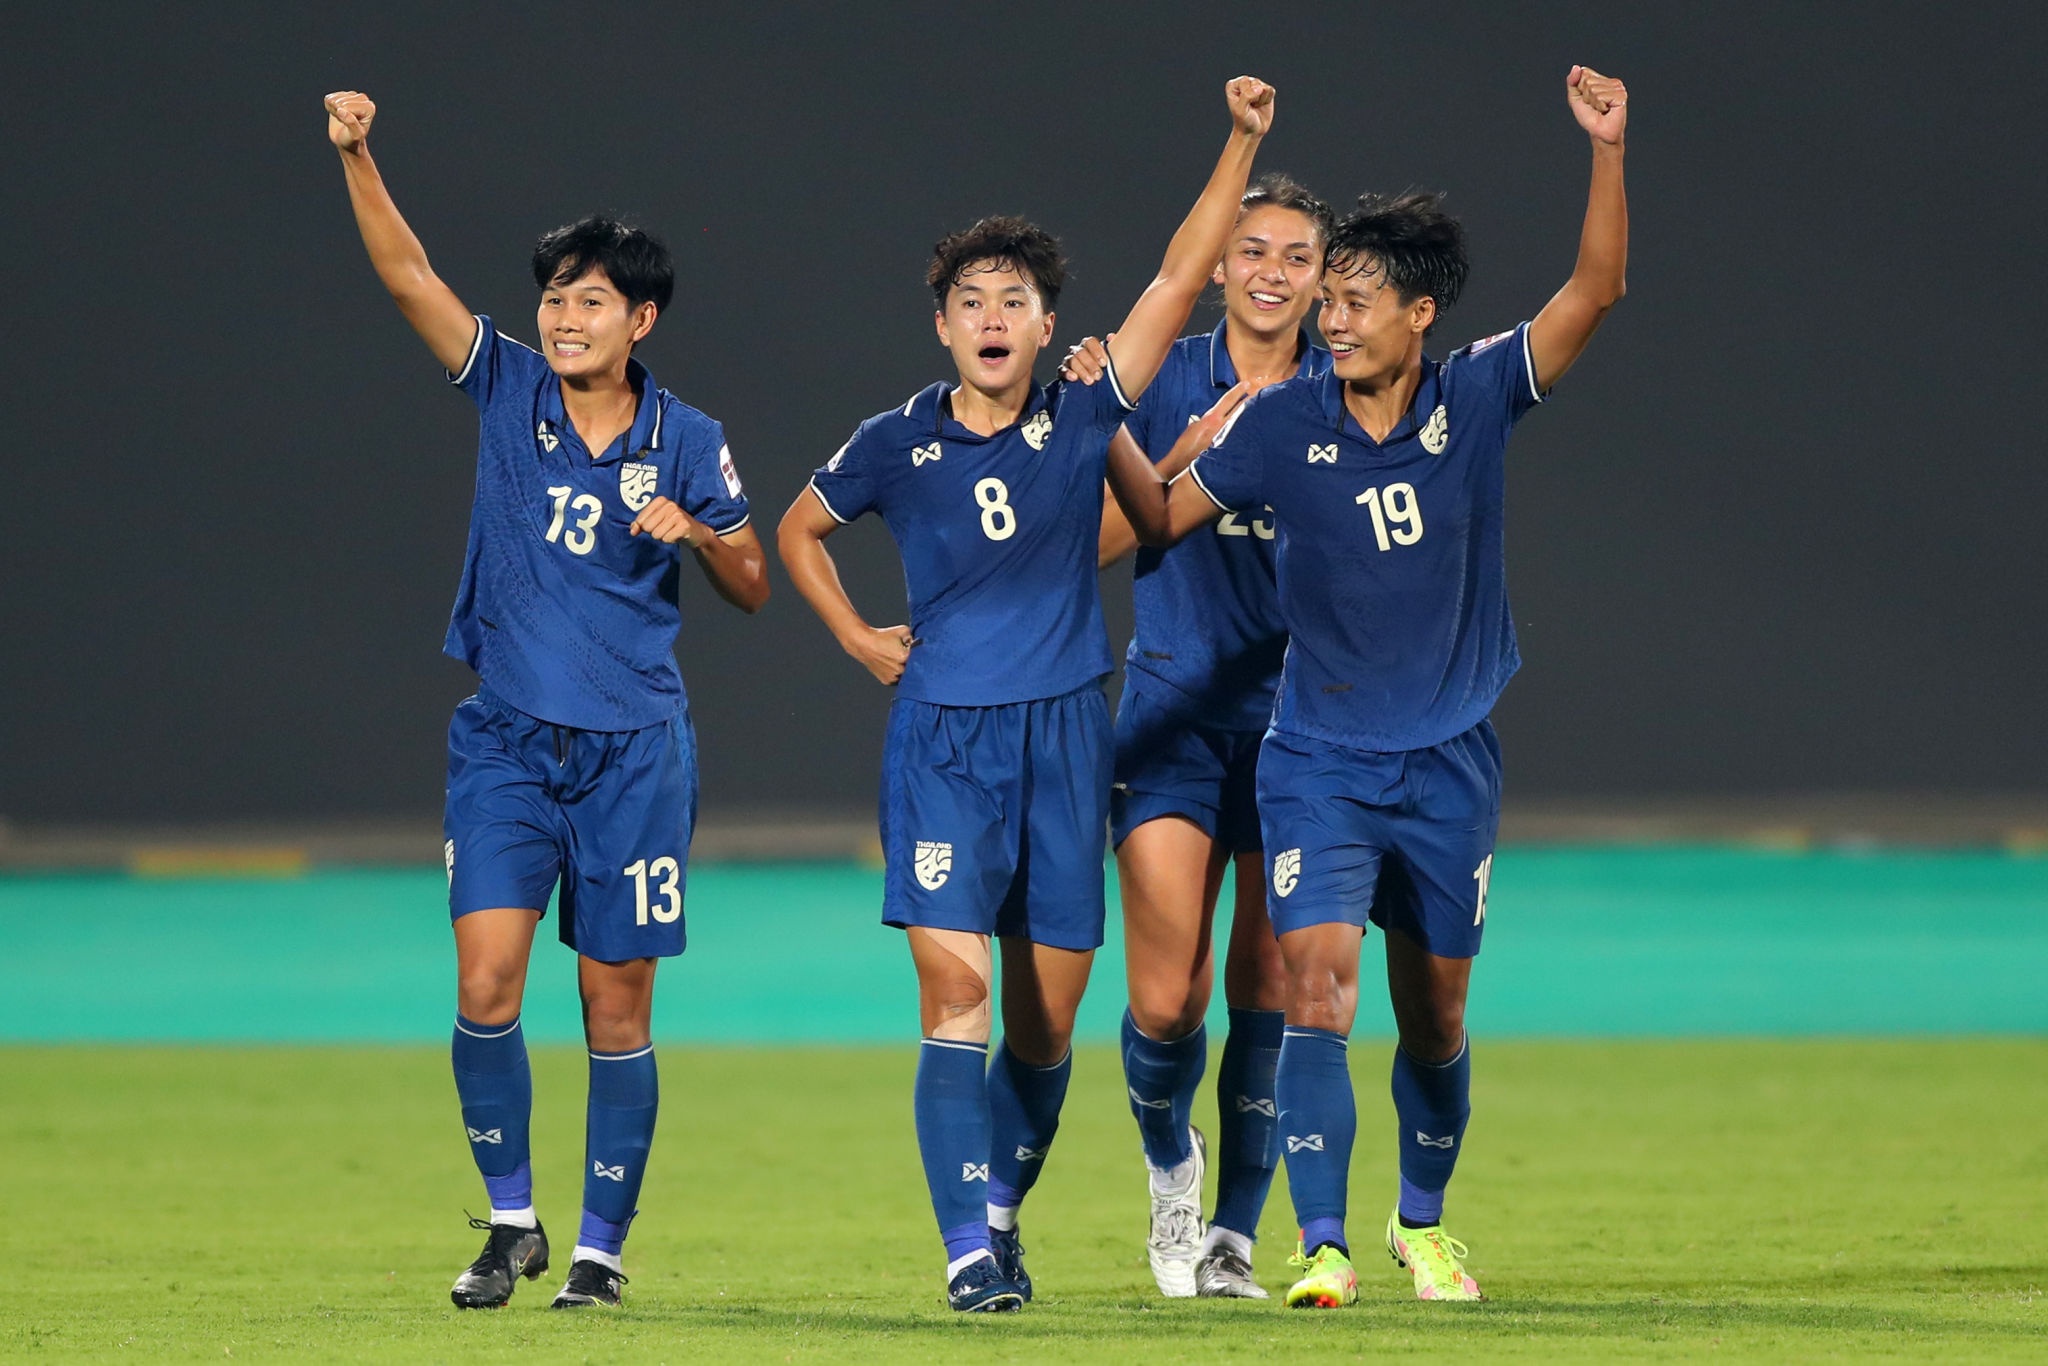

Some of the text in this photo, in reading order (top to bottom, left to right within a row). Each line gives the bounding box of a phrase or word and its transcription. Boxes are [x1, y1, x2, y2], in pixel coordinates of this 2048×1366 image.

[545, 485, 603, 556] 13
[974, 477, 1017, 541] 8
[1355, 482, 1424, 552] 19
[916, 841, 952, 850] THAILAND
[623, 856, 682, 926] 13
